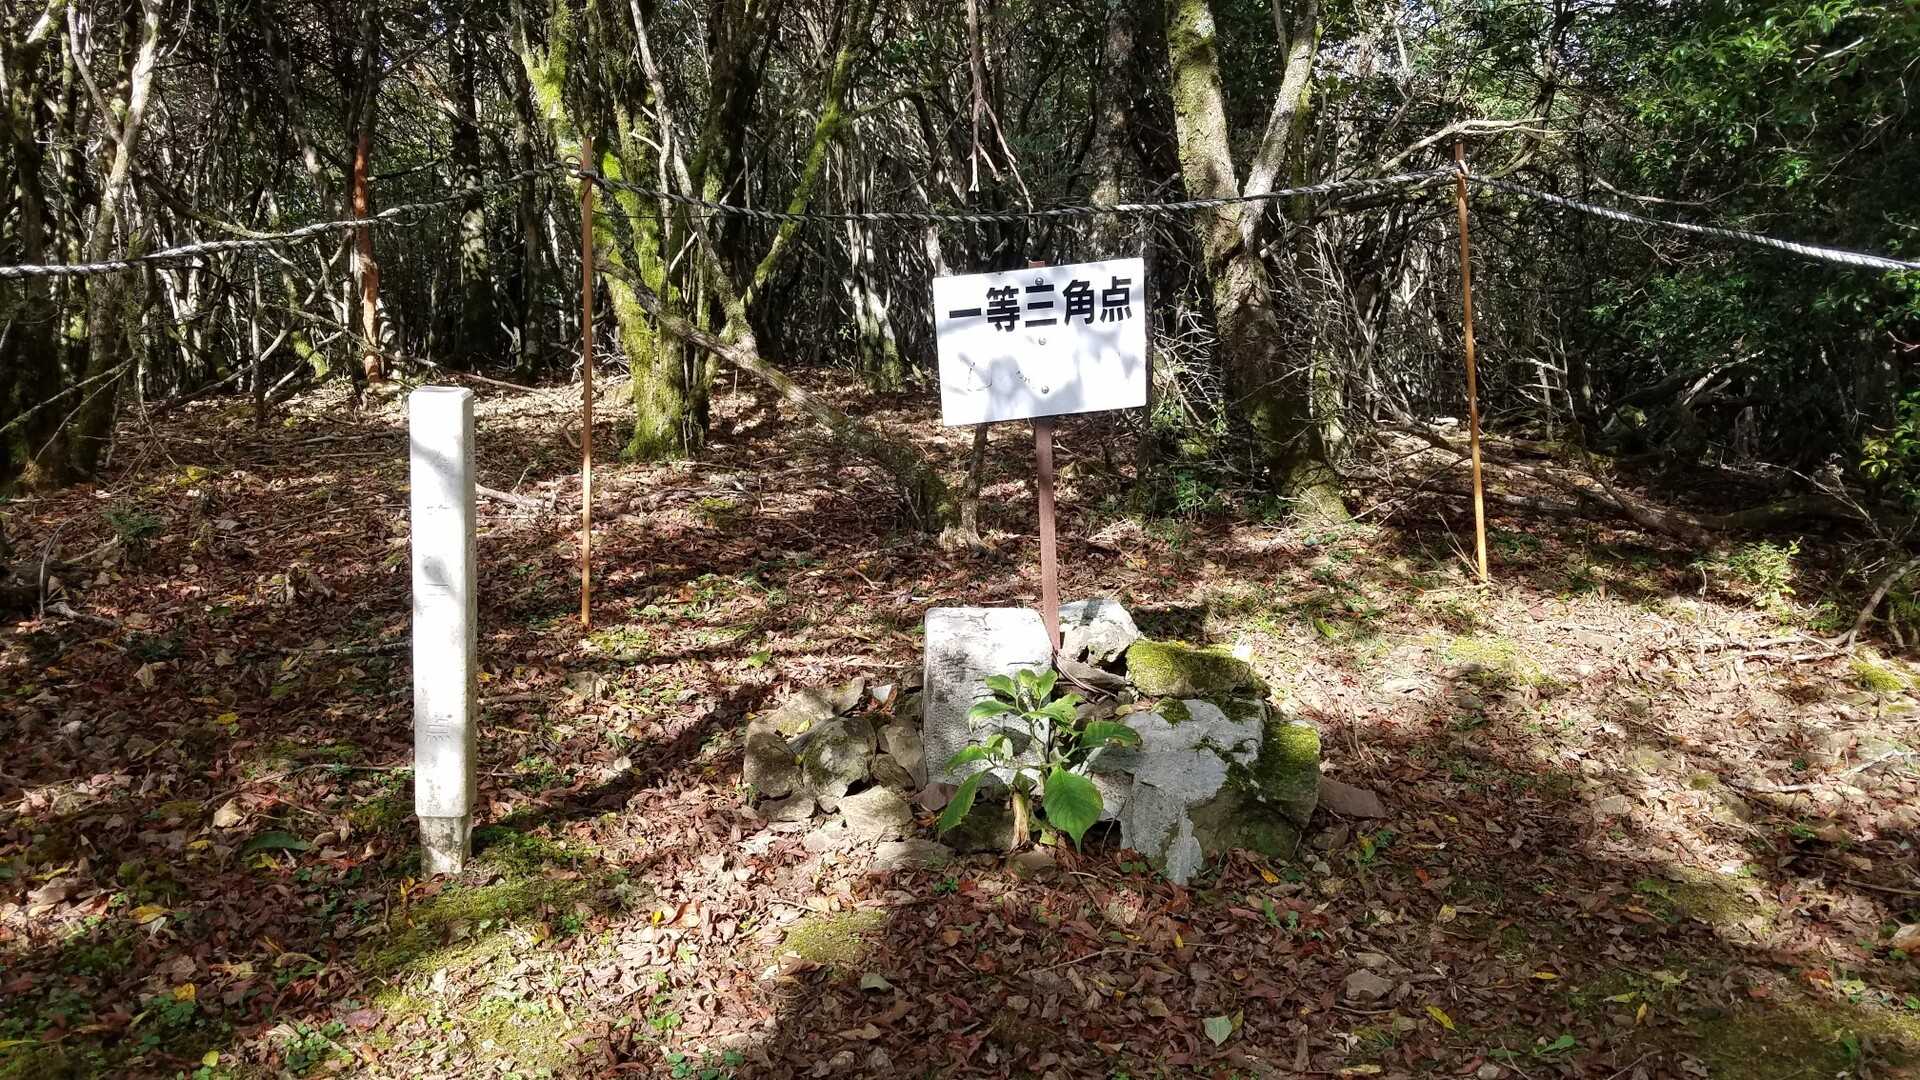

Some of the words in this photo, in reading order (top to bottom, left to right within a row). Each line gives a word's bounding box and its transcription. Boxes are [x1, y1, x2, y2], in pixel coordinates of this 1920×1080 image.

[949, 276, 1132, 331] 一等三角点
